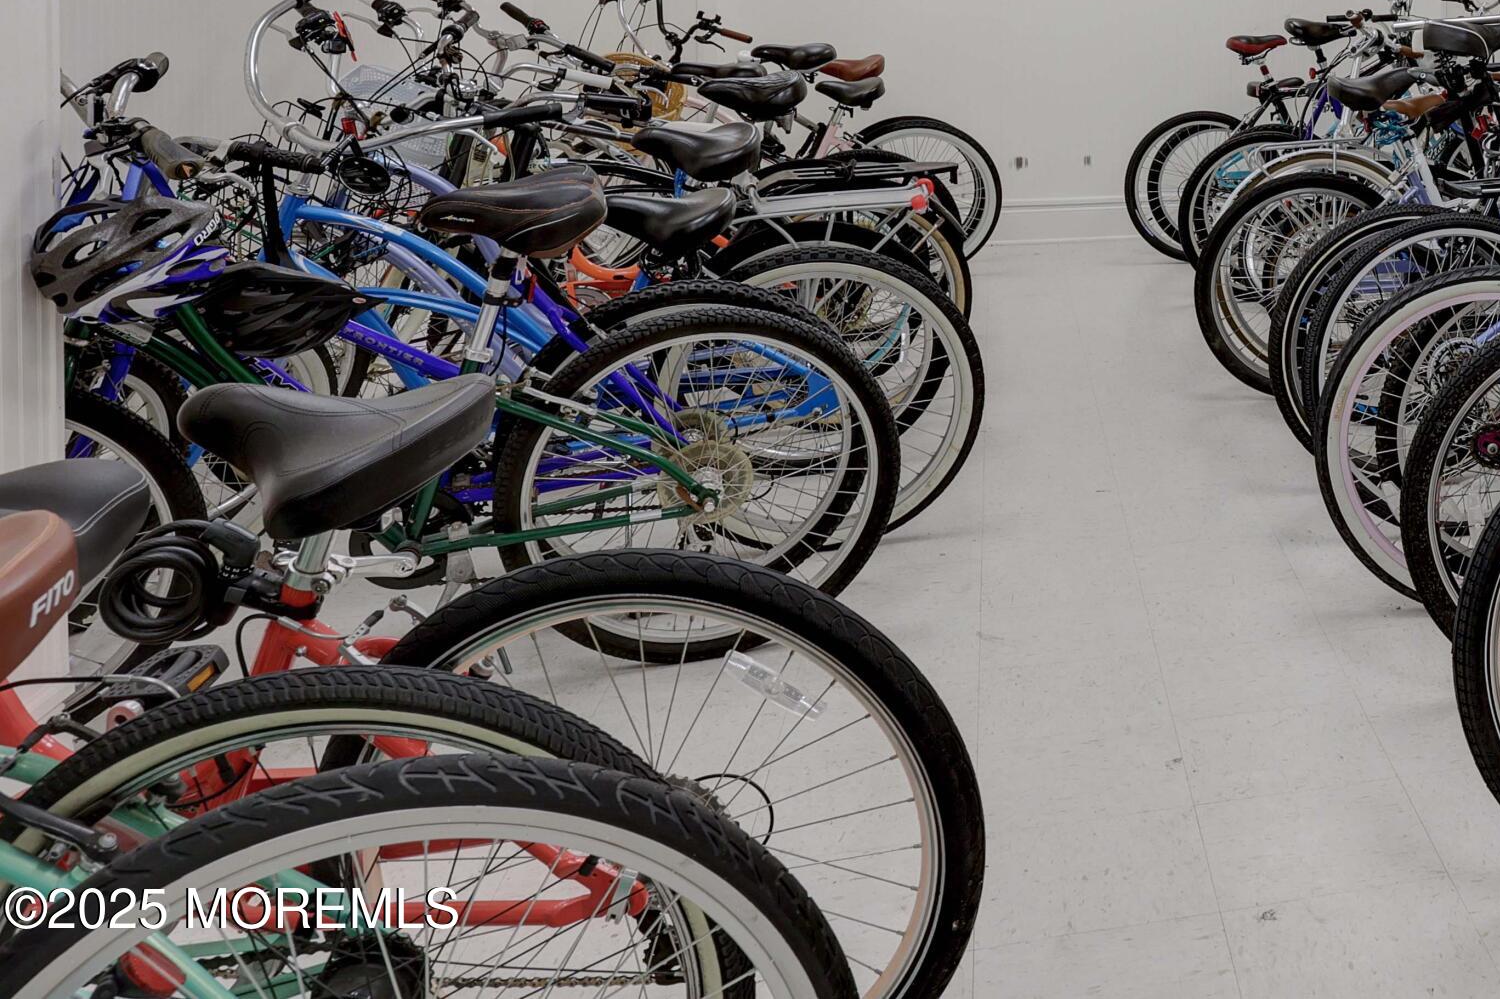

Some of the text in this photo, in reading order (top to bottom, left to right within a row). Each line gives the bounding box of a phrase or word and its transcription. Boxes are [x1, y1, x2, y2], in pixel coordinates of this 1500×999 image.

[194, 219, 217, 246] GIRO
[342, 326, 425, 367] FRONTIER
[29, 569, 75, 628] FITO
